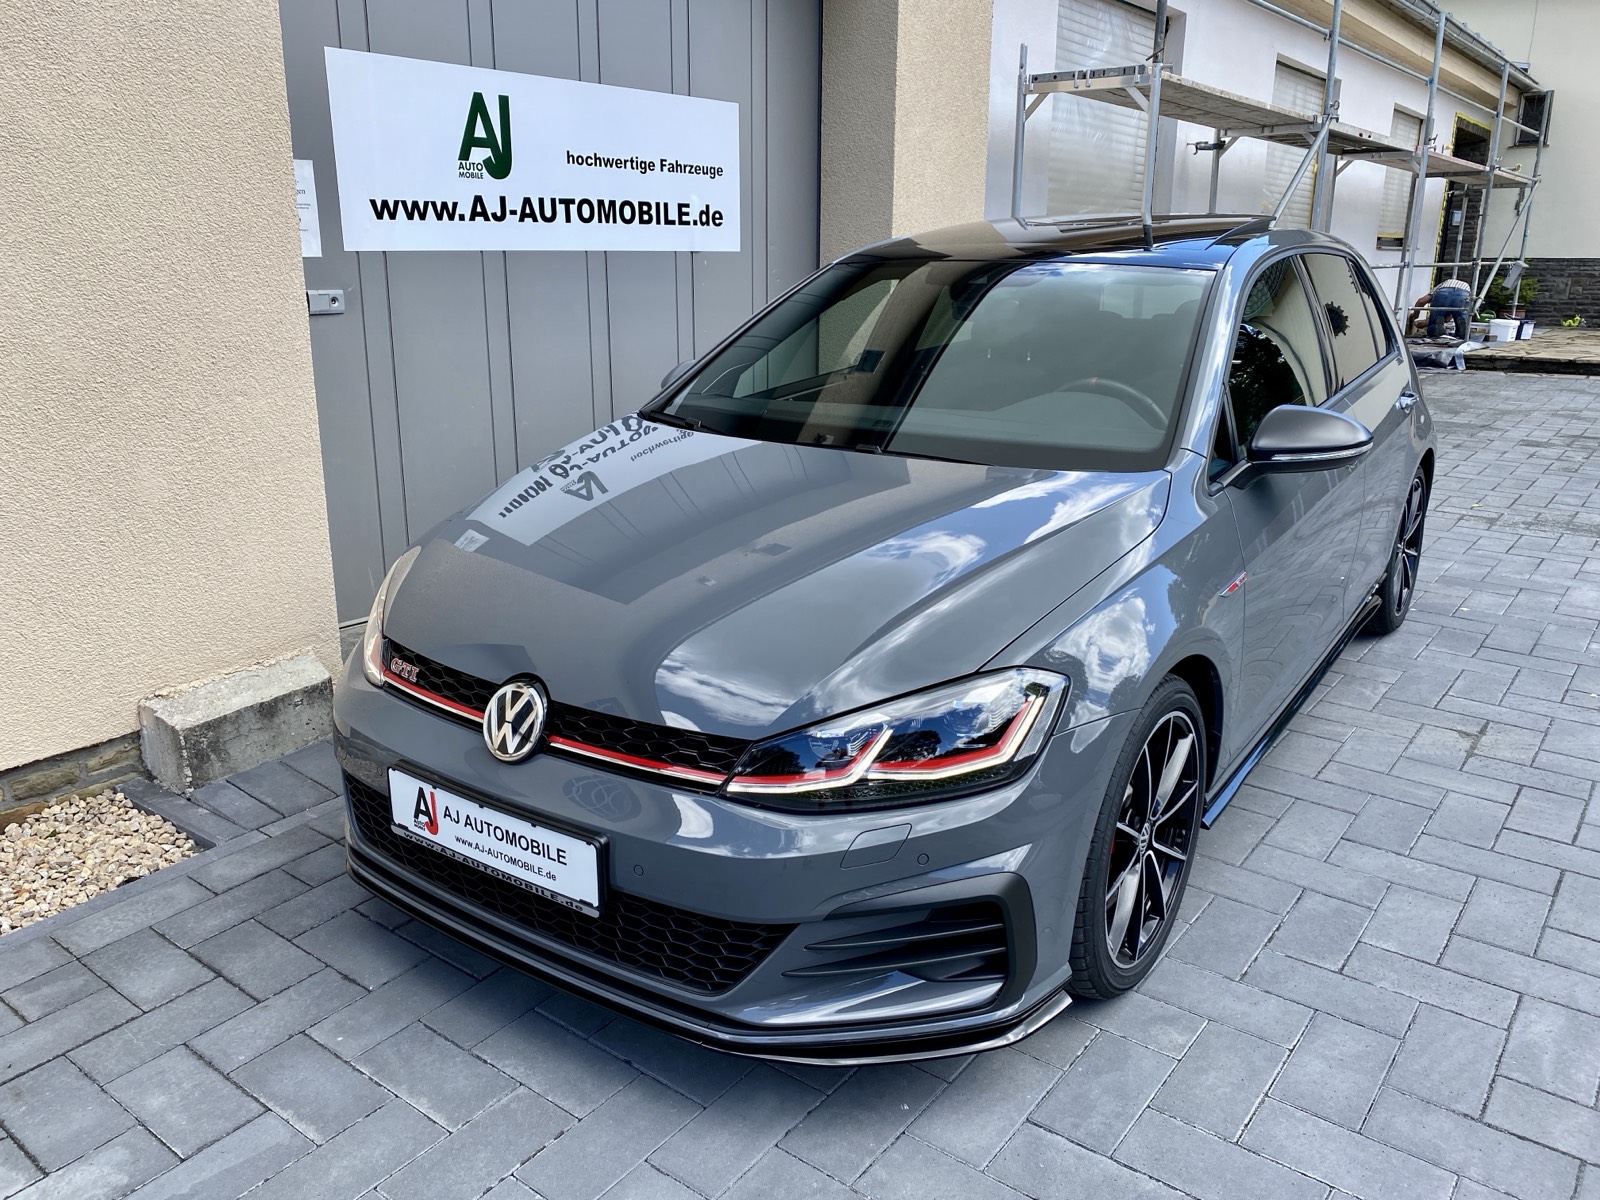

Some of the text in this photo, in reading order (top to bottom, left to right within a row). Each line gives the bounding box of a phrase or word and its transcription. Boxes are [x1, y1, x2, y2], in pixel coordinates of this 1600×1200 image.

[458, 91, 512, 180] AJ
[458, 161, 484, 171] AUTO
[458, 171, 484, 179] MOBILE
[566, 150, 724, 178] hochwertige Fahrzeuge
[369, 194, 724, 227] www.AJ-AUTOMOBILE.de
[390, 657, 419, 683] GTI
[413, 786, 438, 836] AJ
[443, 805, 568, 866] AJ AUTOMOBILE
[403, 831, 584, 912] www.AJ-AUTOMOBILE.de
[454, 835, 557, 882] www.AJ-AUTOMOBILE.de
